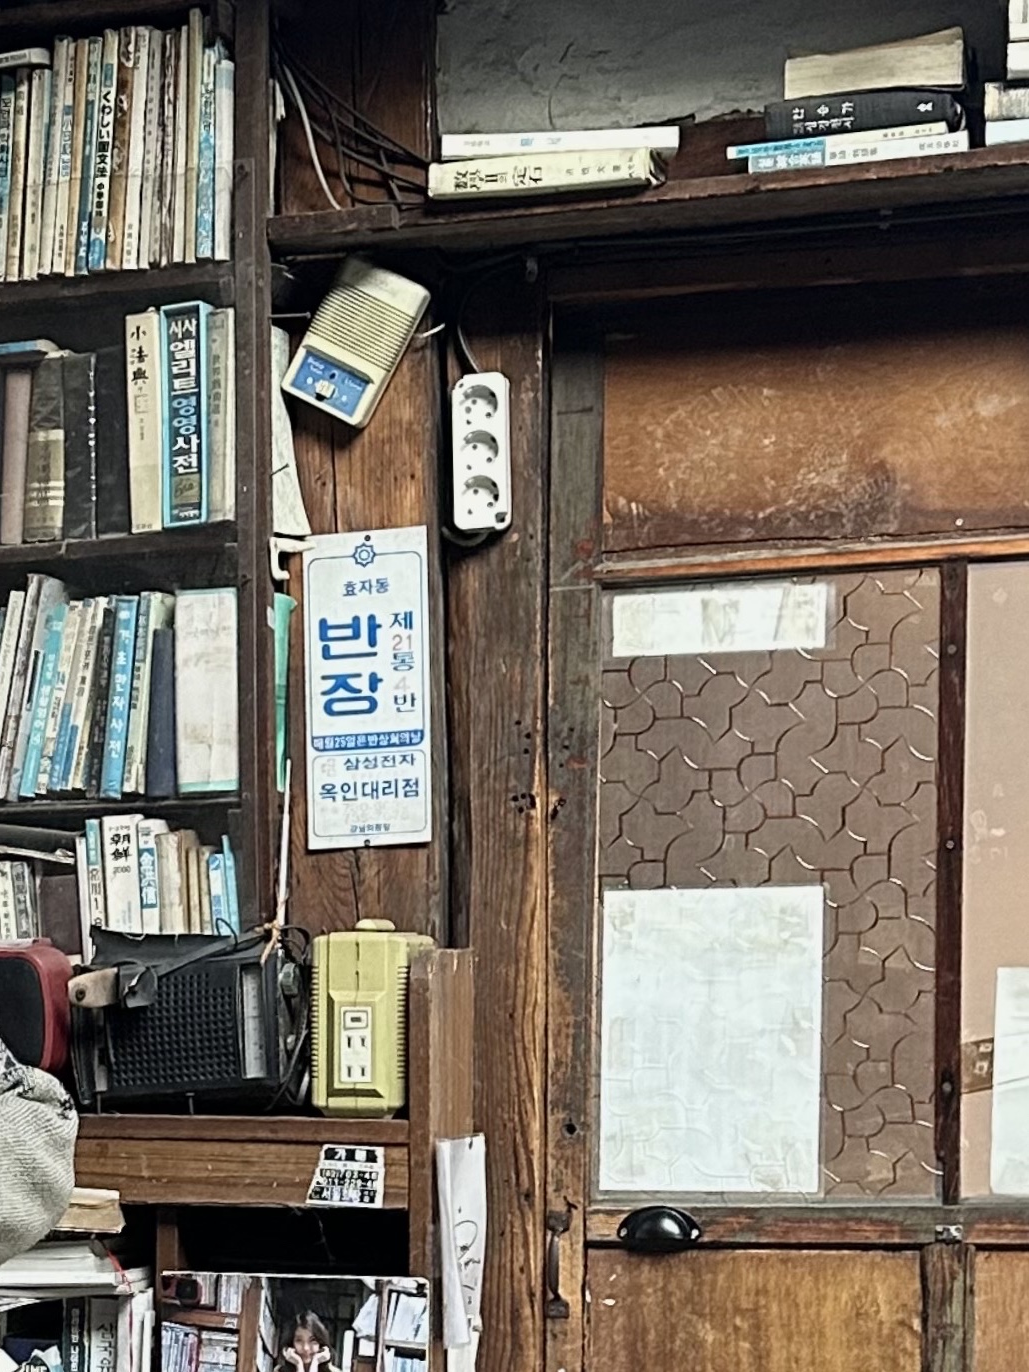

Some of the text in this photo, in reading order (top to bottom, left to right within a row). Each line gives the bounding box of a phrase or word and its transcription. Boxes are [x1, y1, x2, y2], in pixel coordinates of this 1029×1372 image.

[342, 578, 389, 597] 효자동
[319, 613, 384, 716] 반장
[344, 753, 417, 771] 삼성전자
[319, 778, 419, 802] 옥인대리점
